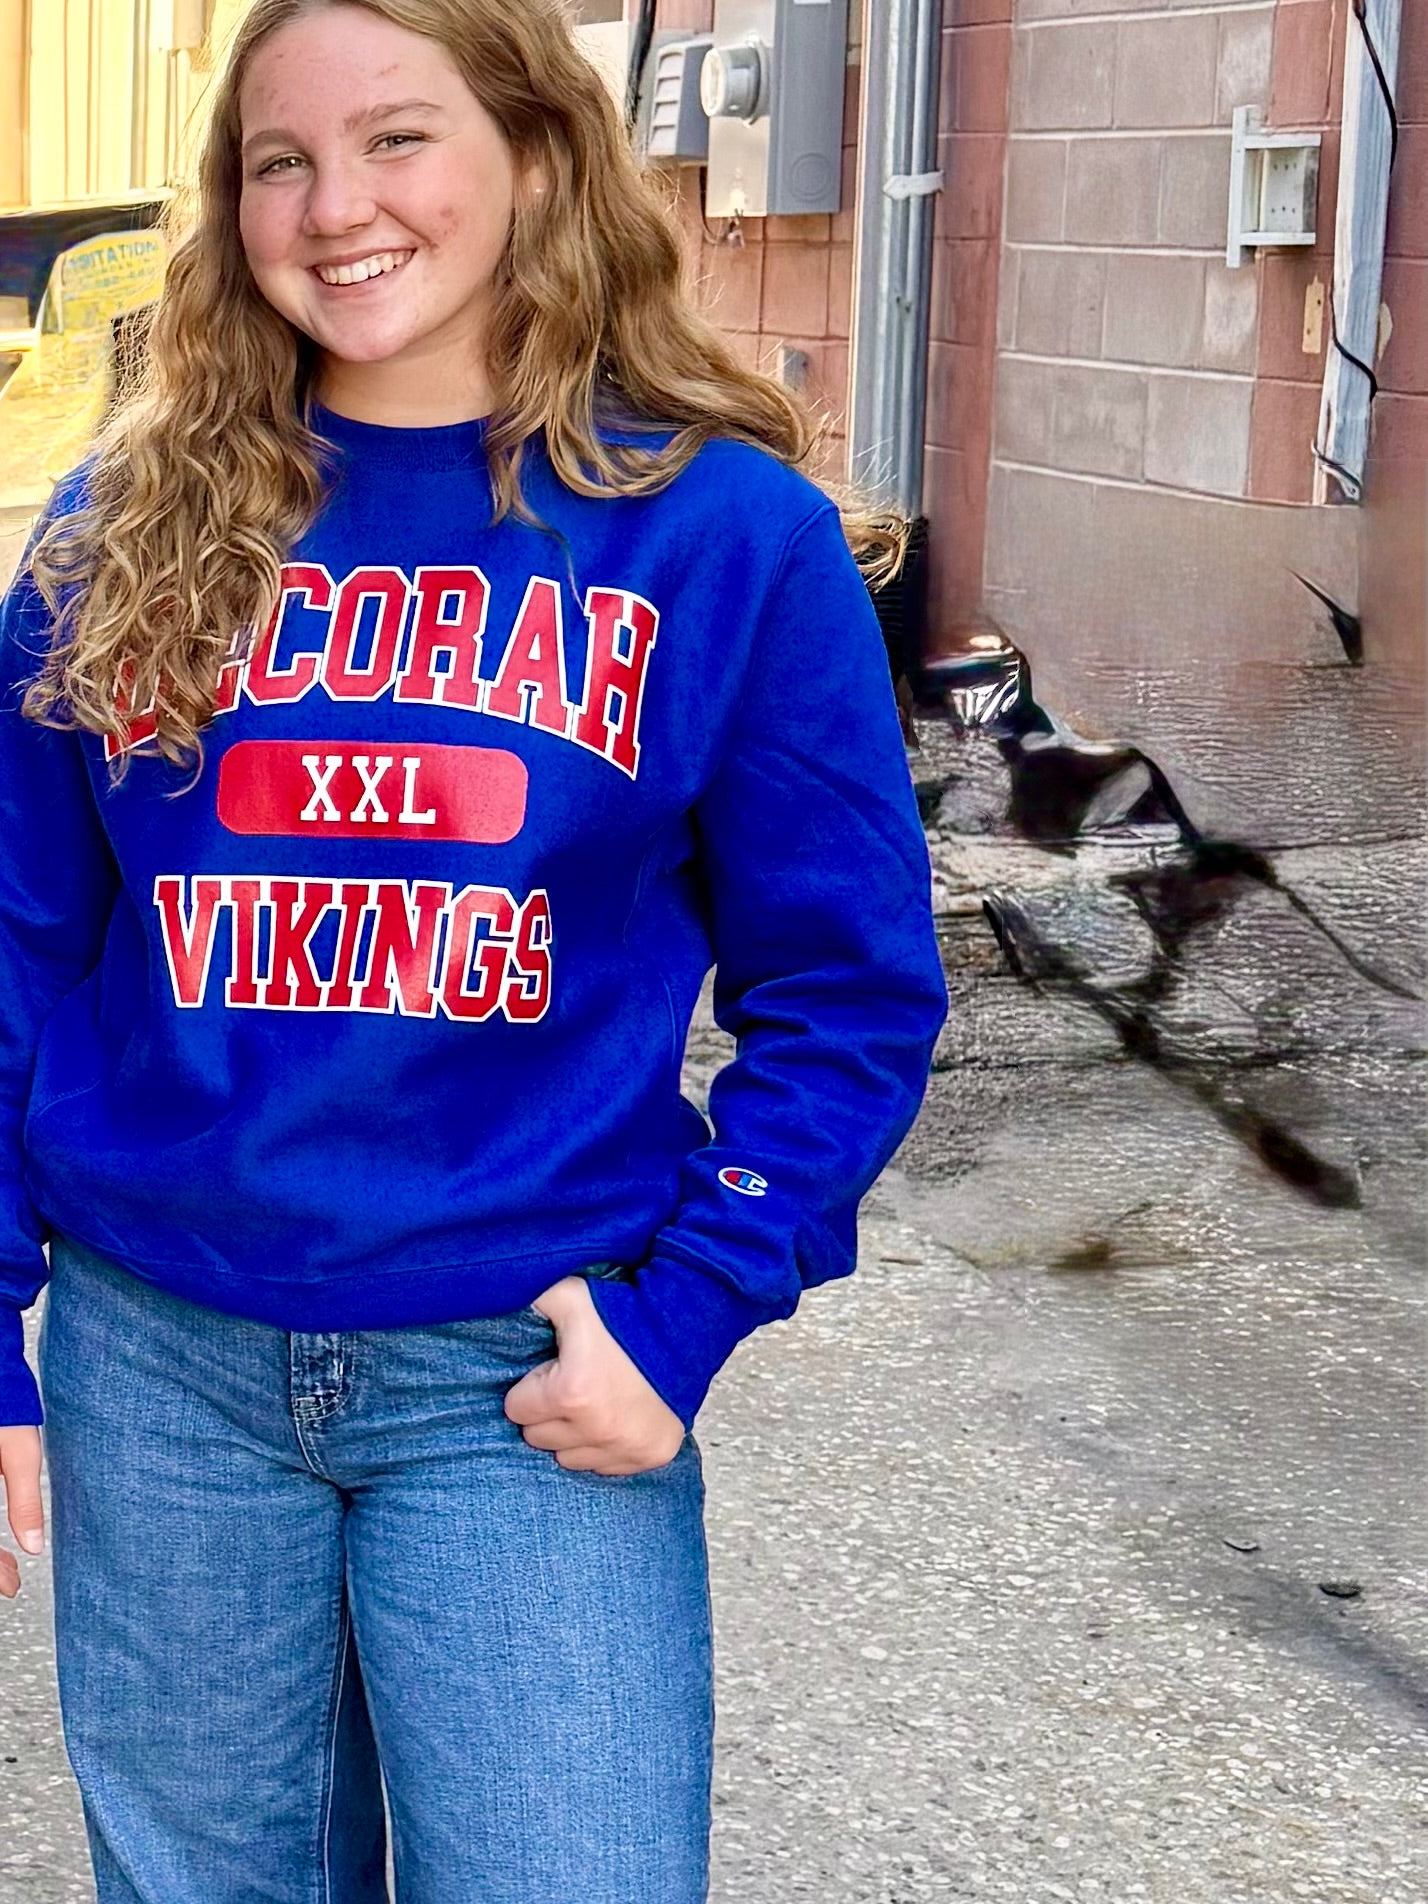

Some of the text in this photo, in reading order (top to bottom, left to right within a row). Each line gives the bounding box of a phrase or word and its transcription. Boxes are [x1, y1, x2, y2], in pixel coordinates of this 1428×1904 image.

[105, 562, 660, 782] CORAH
[299, 754, 436, 824] XXL
[153, 874, 553, 1024] VIKINGS
